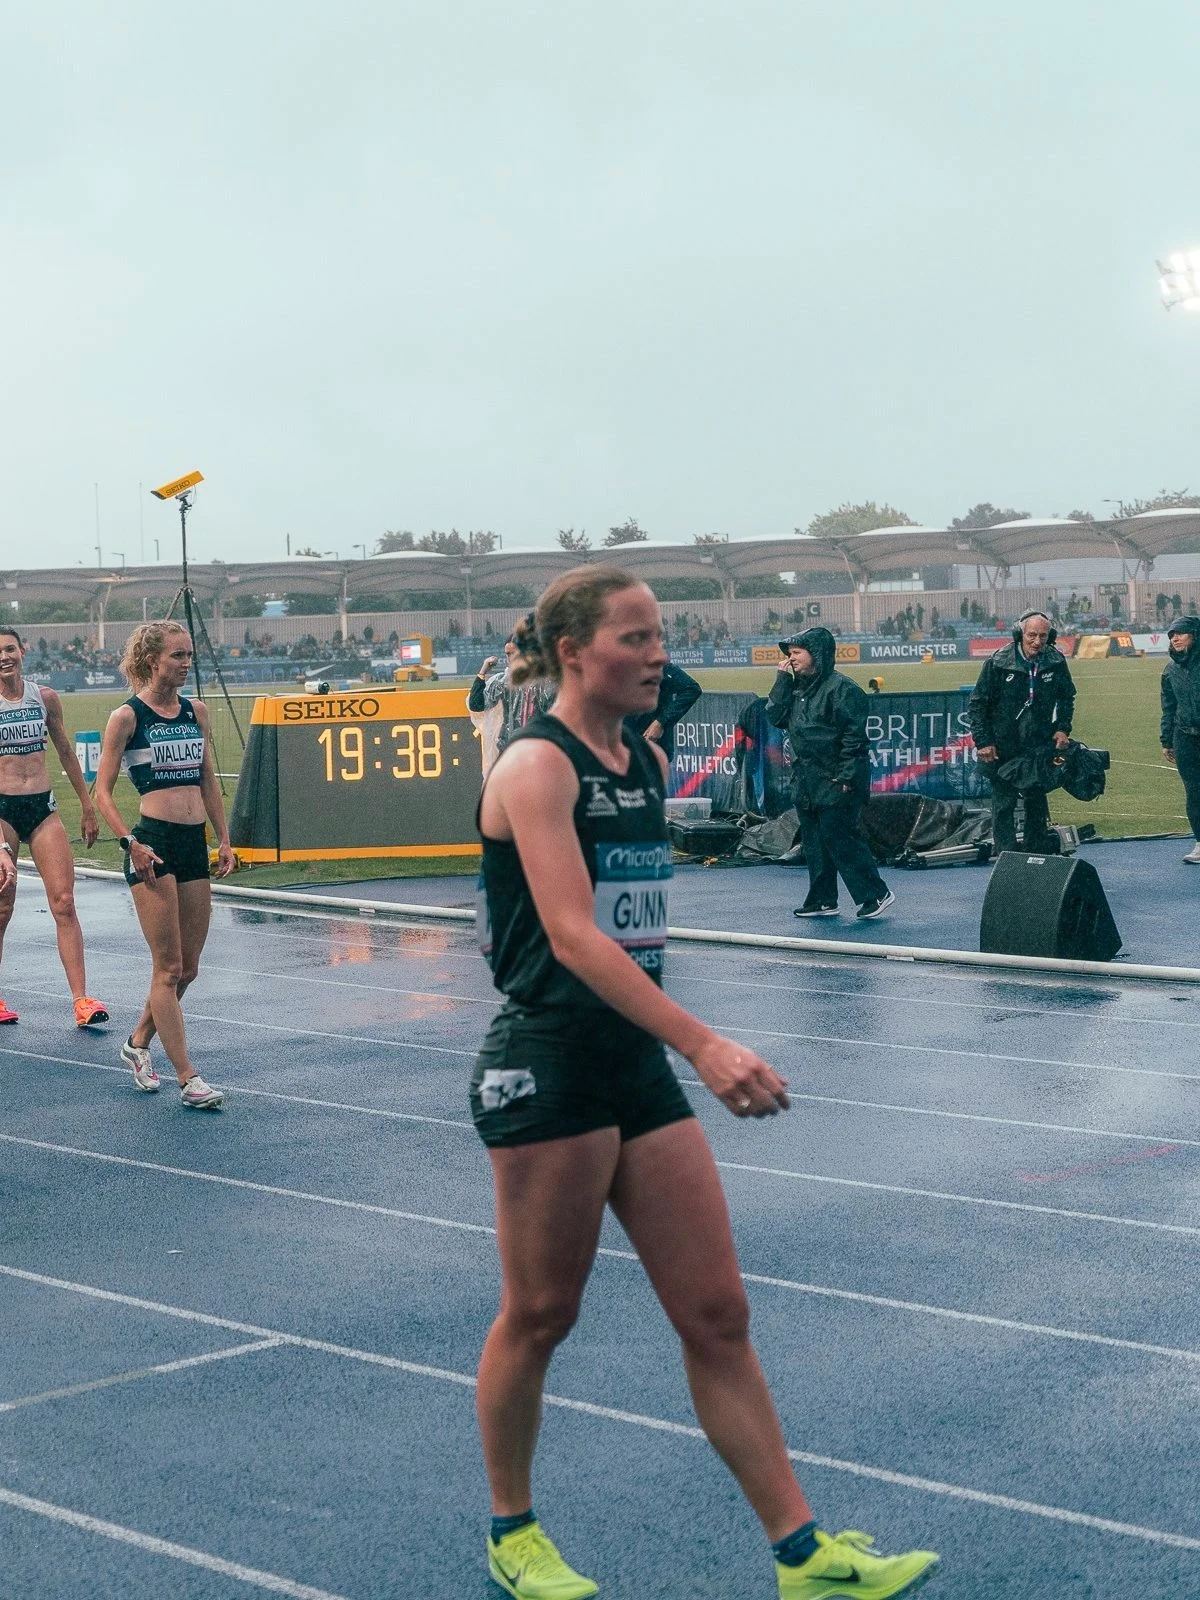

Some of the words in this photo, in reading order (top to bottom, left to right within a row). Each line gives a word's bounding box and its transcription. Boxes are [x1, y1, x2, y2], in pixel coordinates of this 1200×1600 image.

[166, 480, 191, 496] SEIKO
[809, 604, 818, 614] C
[871, 643, 958, 657] MANCHESTER
[283, 698, 380, 721] SEIKO
[676, 723, 736, 748] BRITISH
[154, 742, 202, 763] WALLACE
[676, 755, 738, 775] ATHLETICS
[614, 889, 668, 929] GUNN
